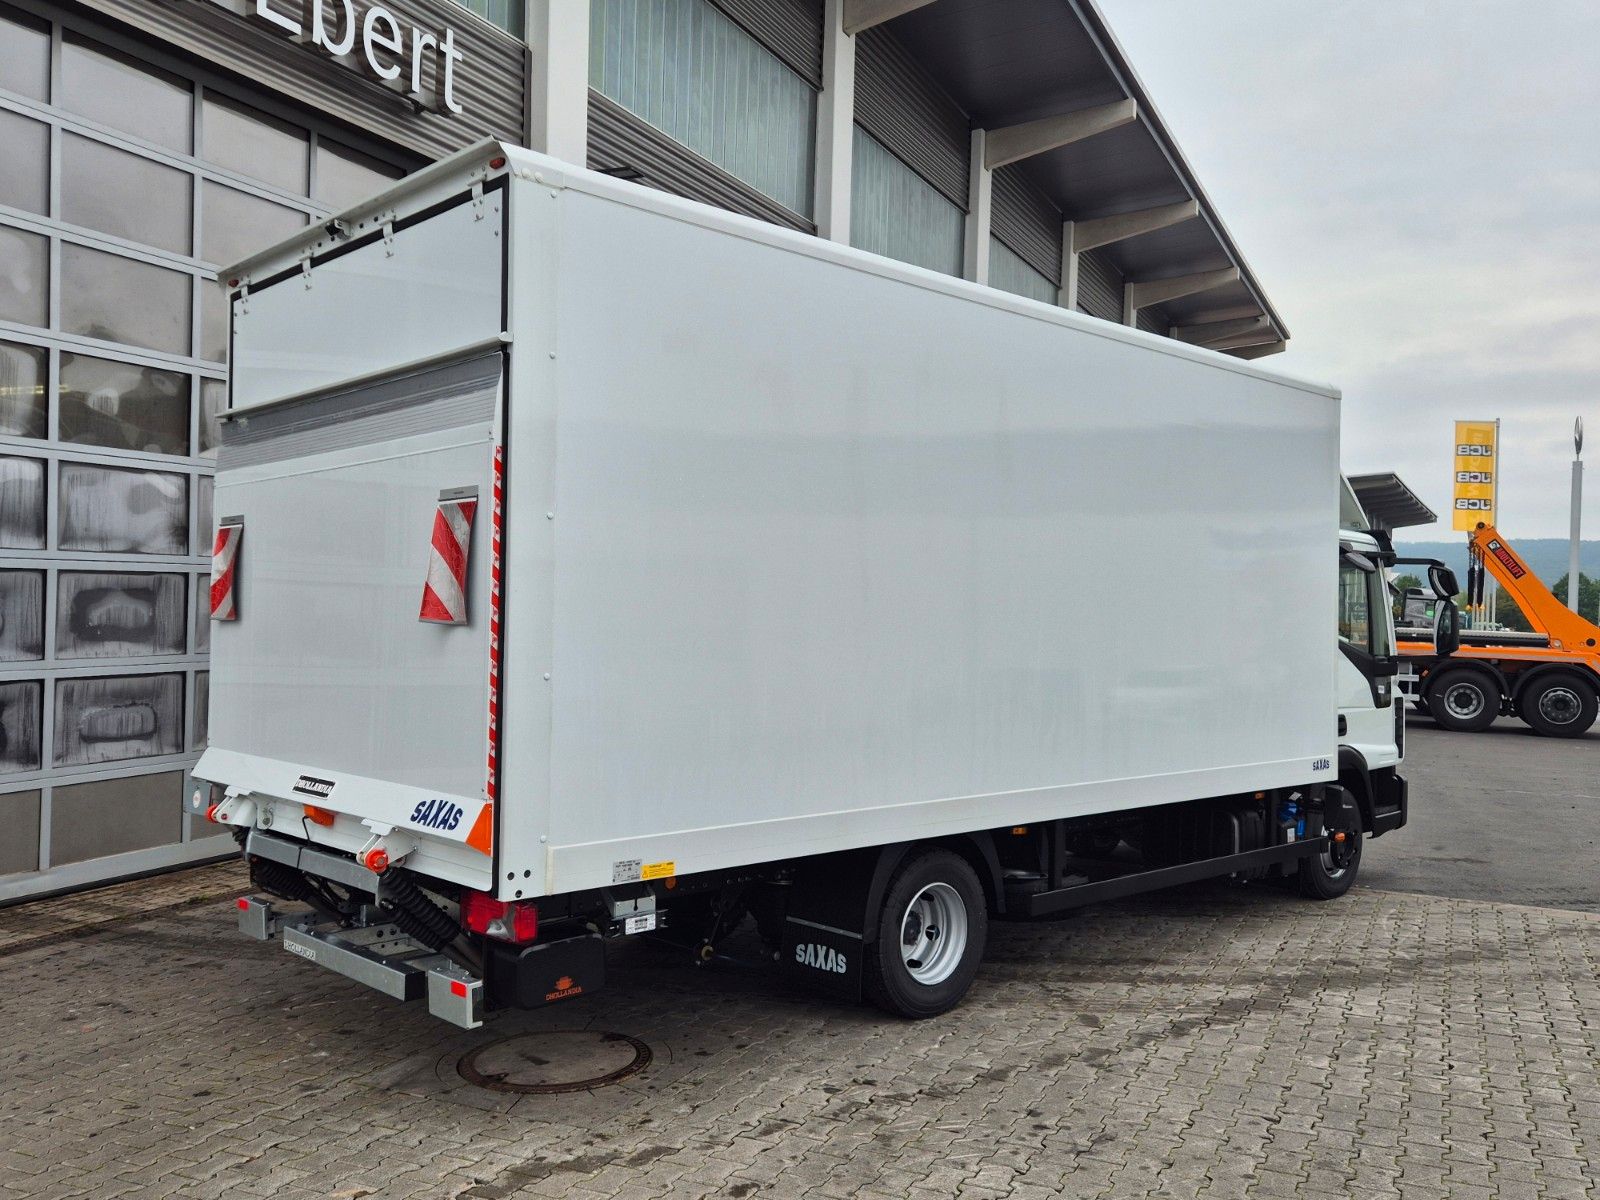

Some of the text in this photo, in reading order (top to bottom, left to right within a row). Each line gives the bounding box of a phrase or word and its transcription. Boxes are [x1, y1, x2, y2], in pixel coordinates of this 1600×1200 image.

[1313, 759, 1330, 771] SAXAS
[410, 799, 463, 830] SAXAS
[795, 943, 847, 974] SAXAS
[545, 986, 582, 1001] DHOLLANDIA
